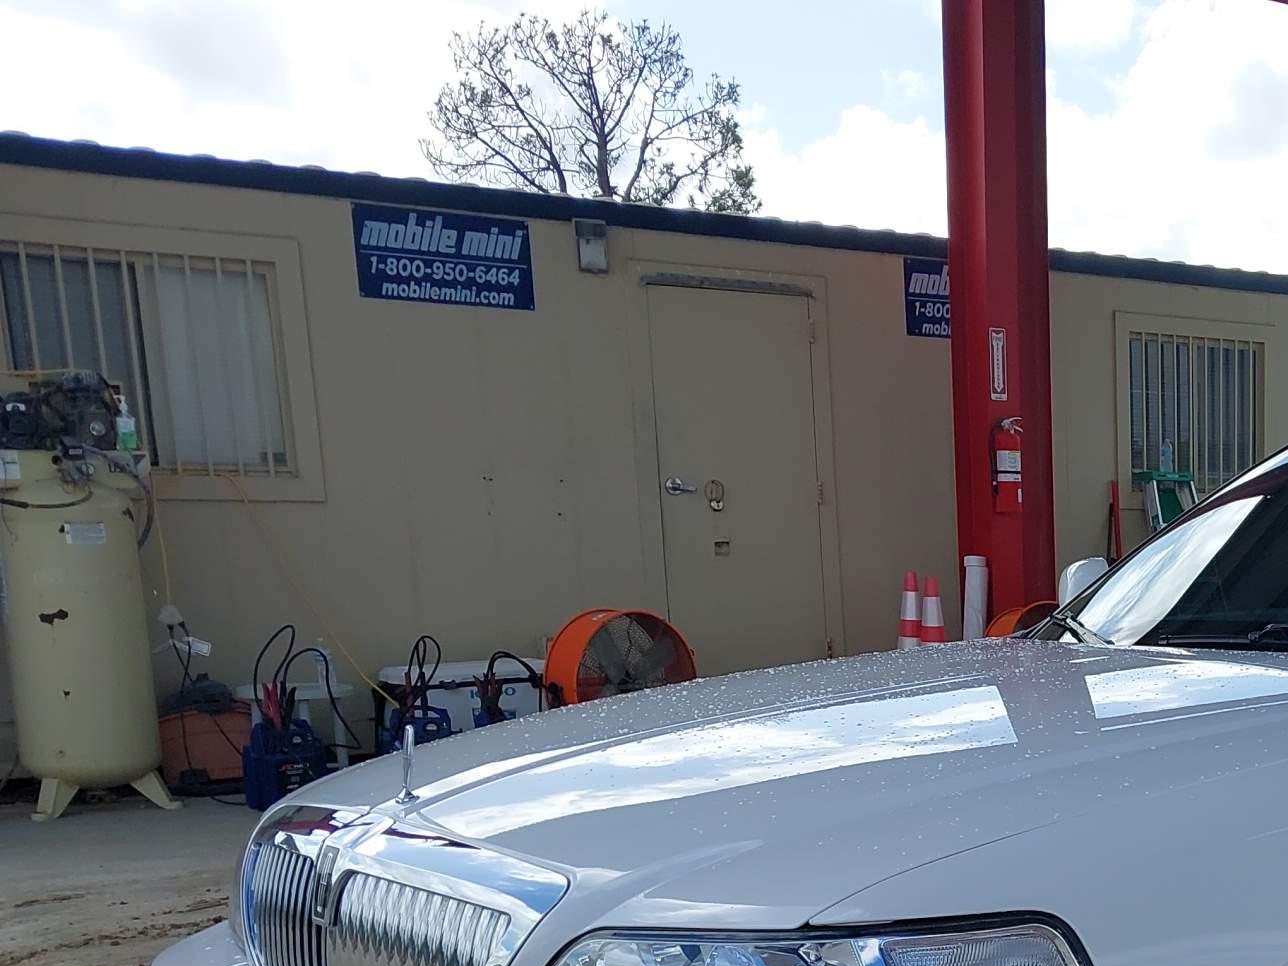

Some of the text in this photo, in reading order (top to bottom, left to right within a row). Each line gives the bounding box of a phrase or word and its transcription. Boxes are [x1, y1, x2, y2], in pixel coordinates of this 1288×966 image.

[361, 213, 523, 260] mobile mini
[370, 256, 520, 287] 1-800-950-6464
[382, 281, 515, 305] mobilemini.com
